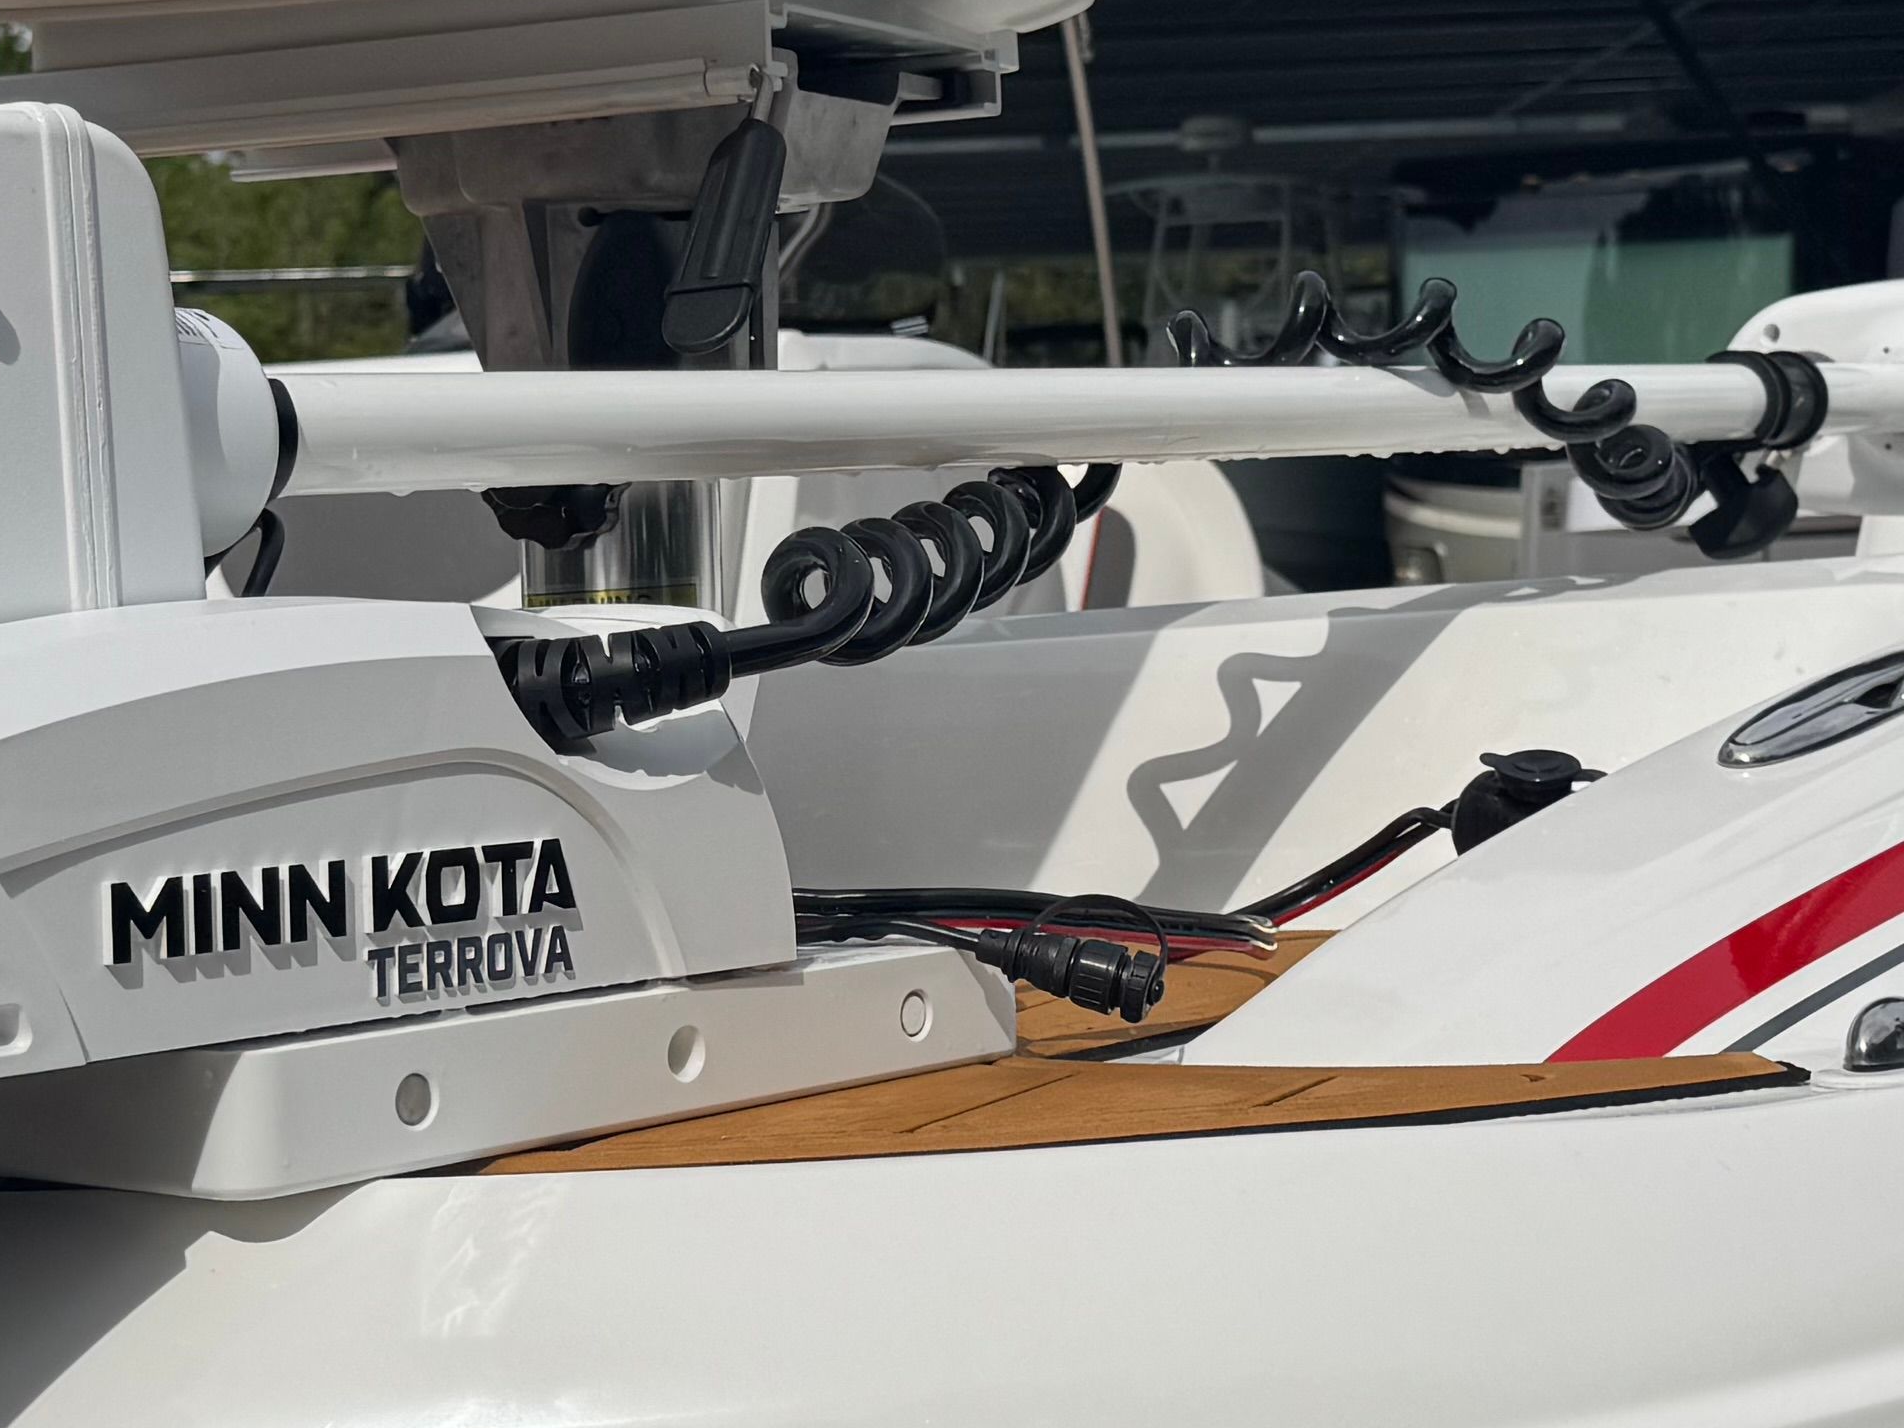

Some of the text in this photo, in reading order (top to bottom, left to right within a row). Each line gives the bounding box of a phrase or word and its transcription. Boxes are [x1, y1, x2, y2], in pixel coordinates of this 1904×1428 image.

[106, 837, 577, 965] MINN KOTA
[367, 925, 575, 999] TERROVA
